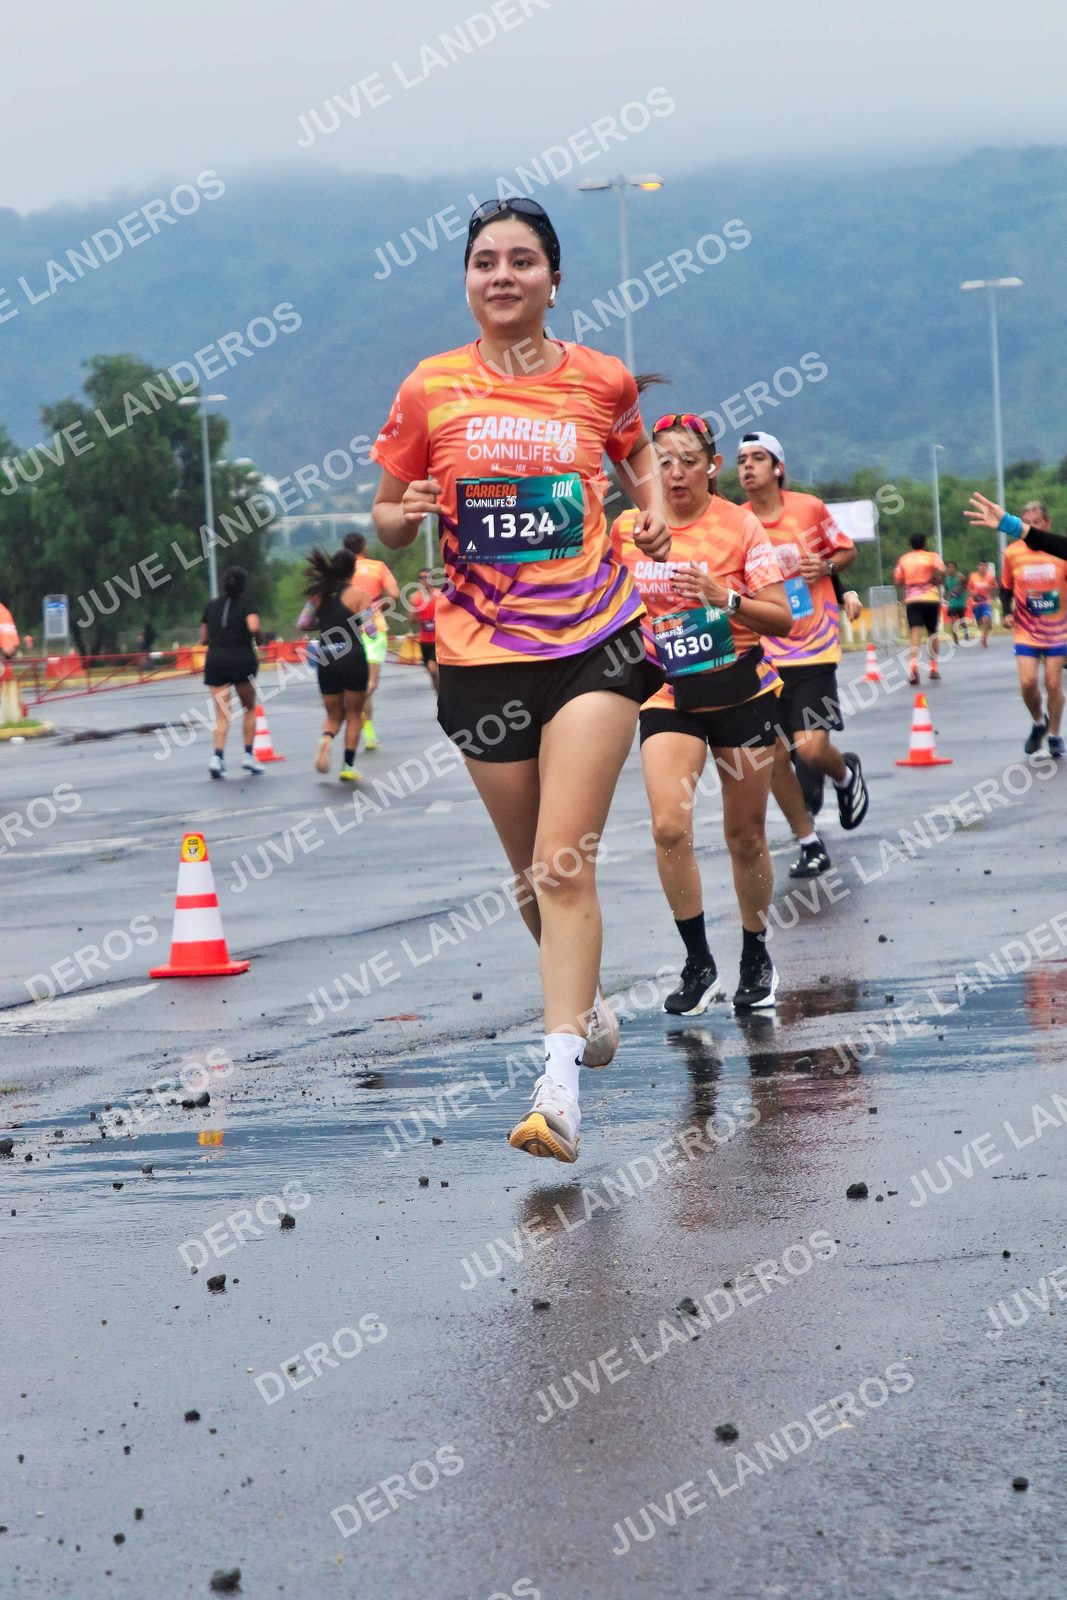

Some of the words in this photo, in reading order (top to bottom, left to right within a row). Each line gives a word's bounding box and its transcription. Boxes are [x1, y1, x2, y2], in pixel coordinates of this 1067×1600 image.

[466, 416, 577, 447] CARRERA
[465, 484, 517, 499] CARRERA
[552, 480, 574, 498] 10K
[481, 511, 556, 539] 1324
[706, 608, 721, 623] 10K
[664, 633, 713, 660] 1630
